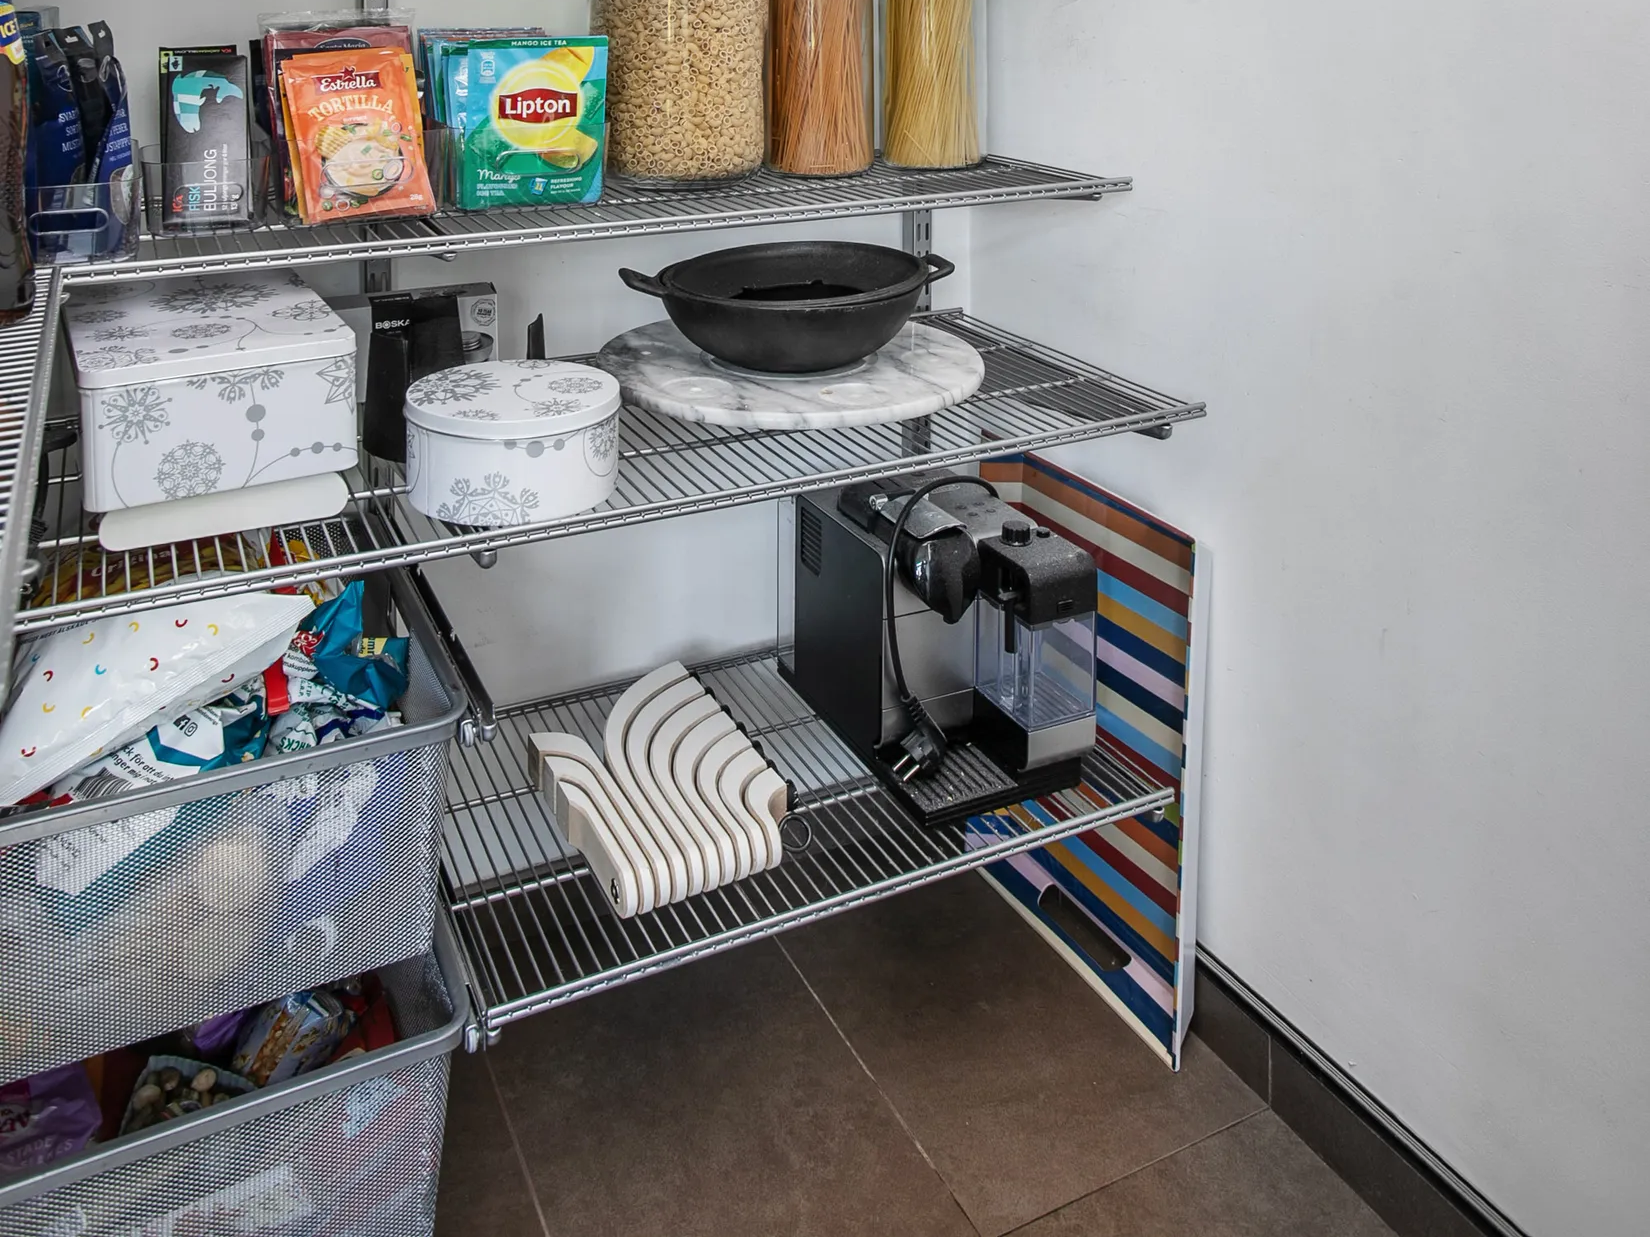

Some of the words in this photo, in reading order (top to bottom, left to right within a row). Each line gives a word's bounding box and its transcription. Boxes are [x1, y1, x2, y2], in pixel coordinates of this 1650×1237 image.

[320, 77, 377, 92] Estrella
[308, 94, 396, 122] TORTILLA
[505, 97, 571, 118] Lipton
[203, 149, 217, 211] BULJONG
[477, 169, 521, 185] Mango
[188, 185, 201, 211] FISK
[375, 319, 410, 330] BOSKA
